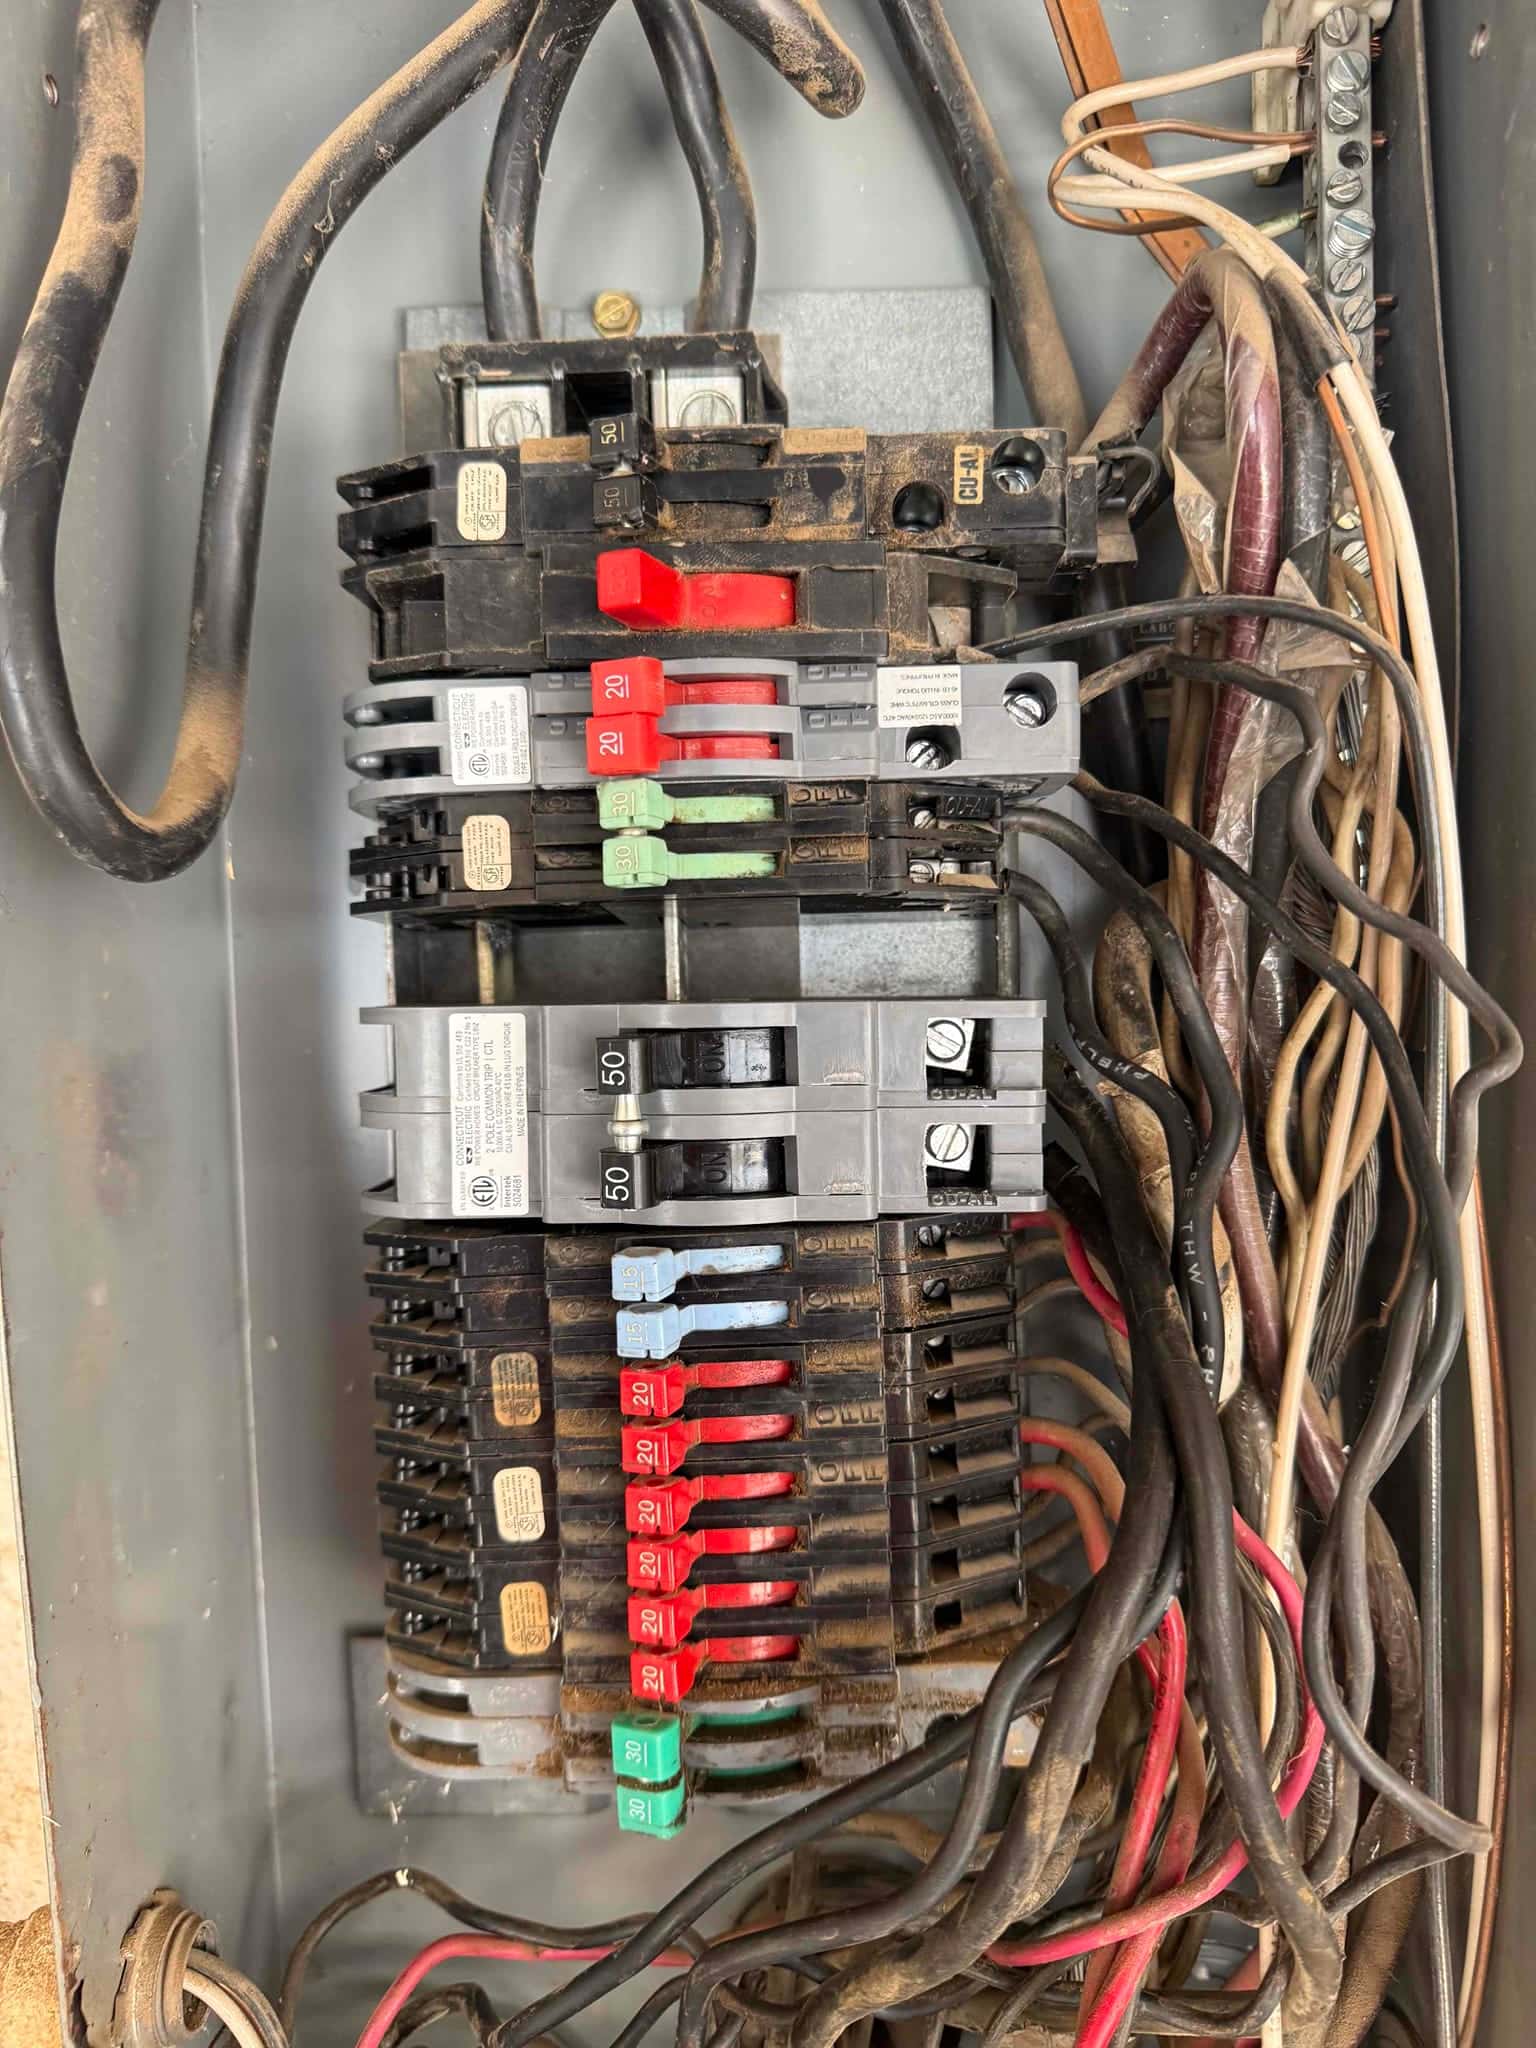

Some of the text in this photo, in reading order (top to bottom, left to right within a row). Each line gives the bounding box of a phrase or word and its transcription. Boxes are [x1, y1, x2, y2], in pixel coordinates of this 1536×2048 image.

[600, 422, 617, 445] 50
[604, 487, 620, 508] 50
[605, 674, 624, 699] 20
[452, 693, 462, 750] CONNECTICUT
[462, 693, 470, 730] ELECTRIC
[600, 732, 618, 756] 20
[612, 791, 628, 818] 30
[614, 846, 631, 871] 30
[503, 1022, 511, 1048] TORQUE
[484, 1040, 493, 1055] CTL
[703, 1038, 726, 1073] ON
[485, 1064, 494, 1081] TRIP
[601, 1051, 625, 1086] 50
[516, 1066, 524, 1107] PHILIPPINES
[930, 1088, 994, 1100] CU-AL
[485, 1083, 494, 1121] COMMON
[456, 1106, 464, 1166] CONNECTICUT
[486, 1122, 494, 1144] POLE
[517, 1117, 525, 1136] MADE
[703, 1150, 728, 1185] ON
[605, 1166, 630, 1202] 50
[931, 1193, 996, 1206] CU-AL
[1180, 1219, 1206, 1287] THW
[622, 1266, 639, 1290] 15
[628, 1322, 644, 1344] 15
[632, 1382, 650, 1406] 20
[815, 1402, 884, 1426] OFF
[636, 1440, 653, 1465] 20
[816, 1461, 885, 1483] OFF
[639, 1500, 656, 1524] 20
[640, 1552, 656, 1576] 20
[640, 1609, 658, 1634] 20
[643, 1666, 660, 1691] 20
[626, 1740, 642, 1763] 30
[630, 1798, 645, 1821] 30
